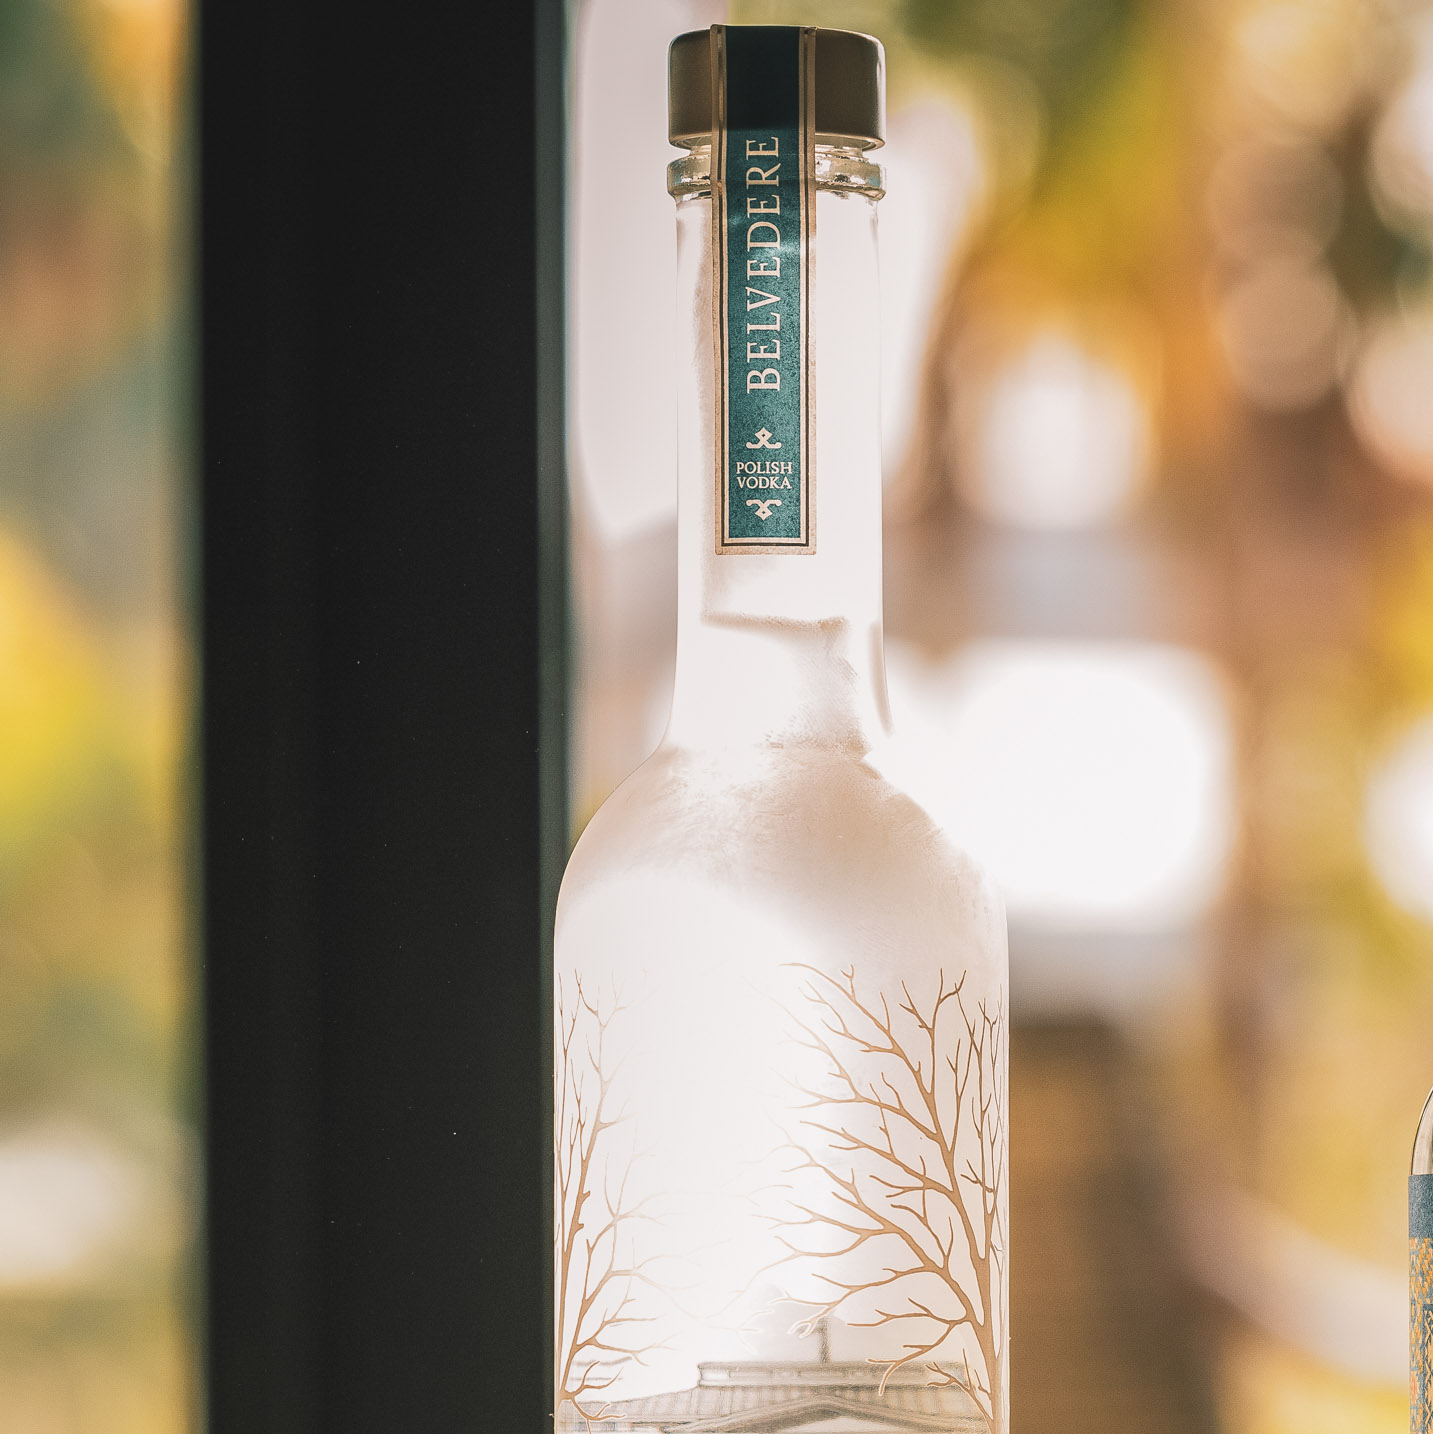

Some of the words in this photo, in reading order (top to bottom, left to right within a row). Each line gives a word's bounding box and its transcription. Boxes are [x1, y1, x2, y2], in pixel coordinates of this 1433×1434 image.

[746, 135, 781, 394] BELVEDERE
[736, 461, 793, 475] POLISH
[736, 475, 792, 490] VODKA
